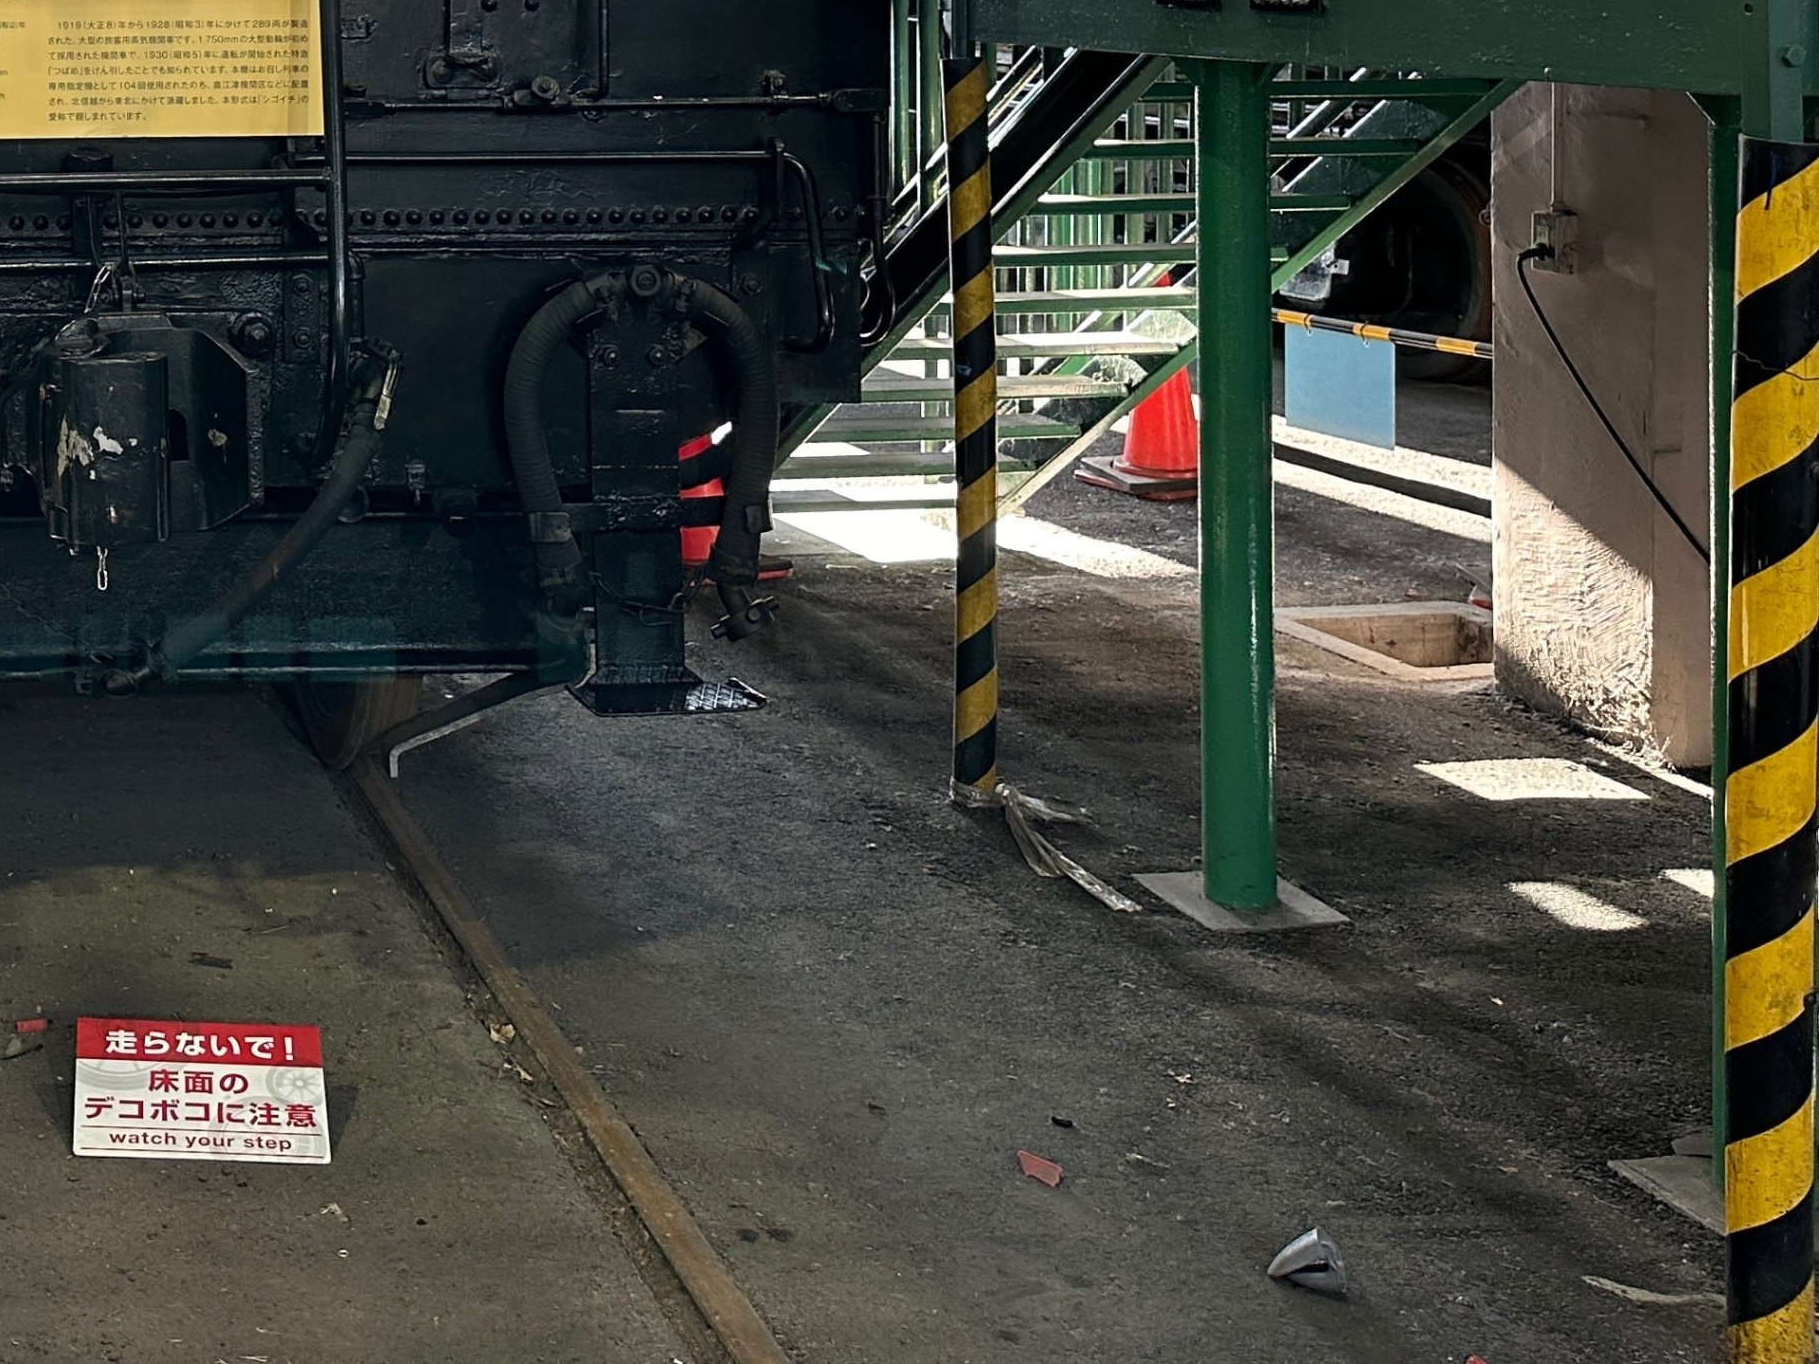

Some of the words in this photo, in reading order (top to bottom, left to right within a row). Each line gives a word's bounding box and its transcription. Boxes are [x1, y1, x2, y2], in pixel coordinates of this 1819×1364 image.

[105, 1029, 295, 1061] 走らないで！
[148, 1069, 249, 1094] 床面の
[84, 1095, 317, 1128] デコボコに注意
[109, 1131, 177, 1145] watch
[185, 1135, 235, 1149] your
[243, 1136, 293, 1152] step
